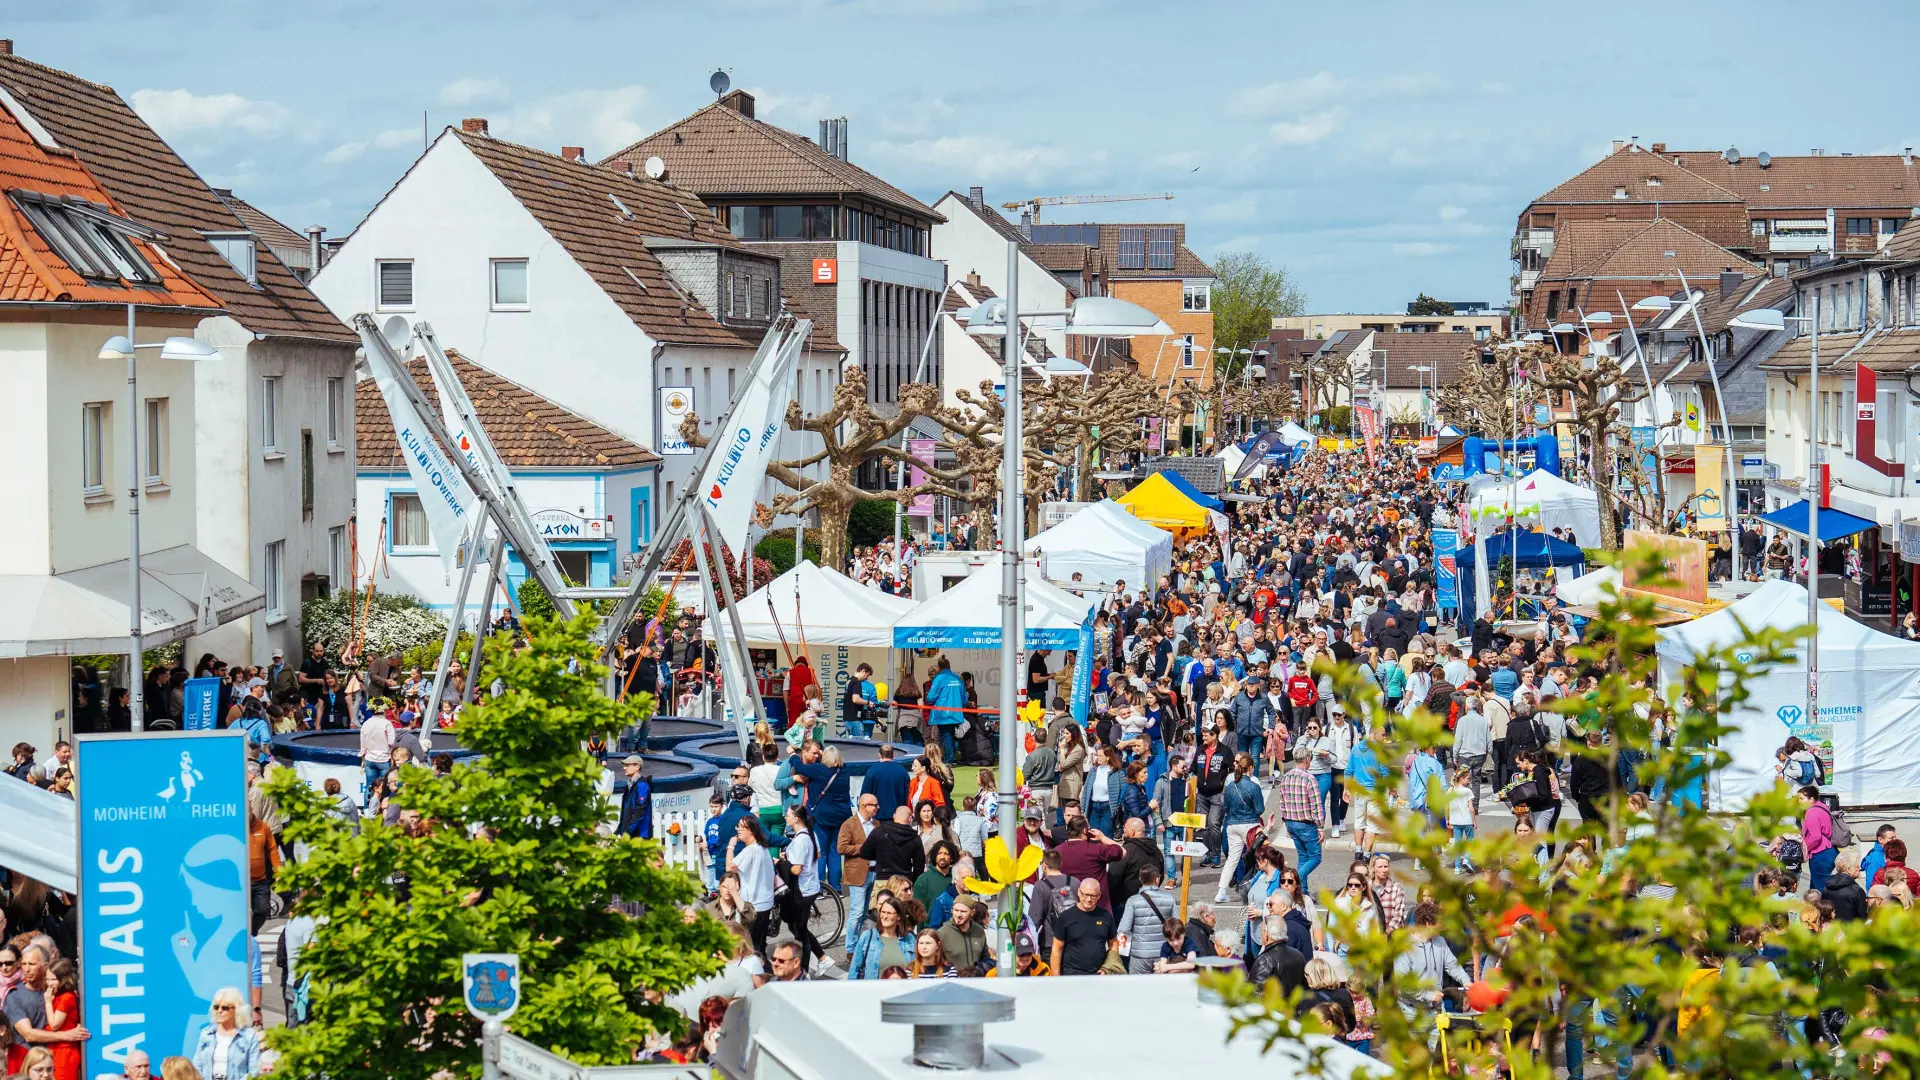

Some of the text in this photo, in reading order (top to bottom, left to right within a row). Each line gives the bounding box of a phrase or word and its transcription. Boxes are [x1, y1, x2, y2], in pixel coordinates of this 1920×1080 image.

[758, 423, 777, 454] ERKE
[94, 805, 167, 822] MONHEIM
[192, 803, 237, 818] RHEIN
[98, 847, 146, 1071] ATHAUS
